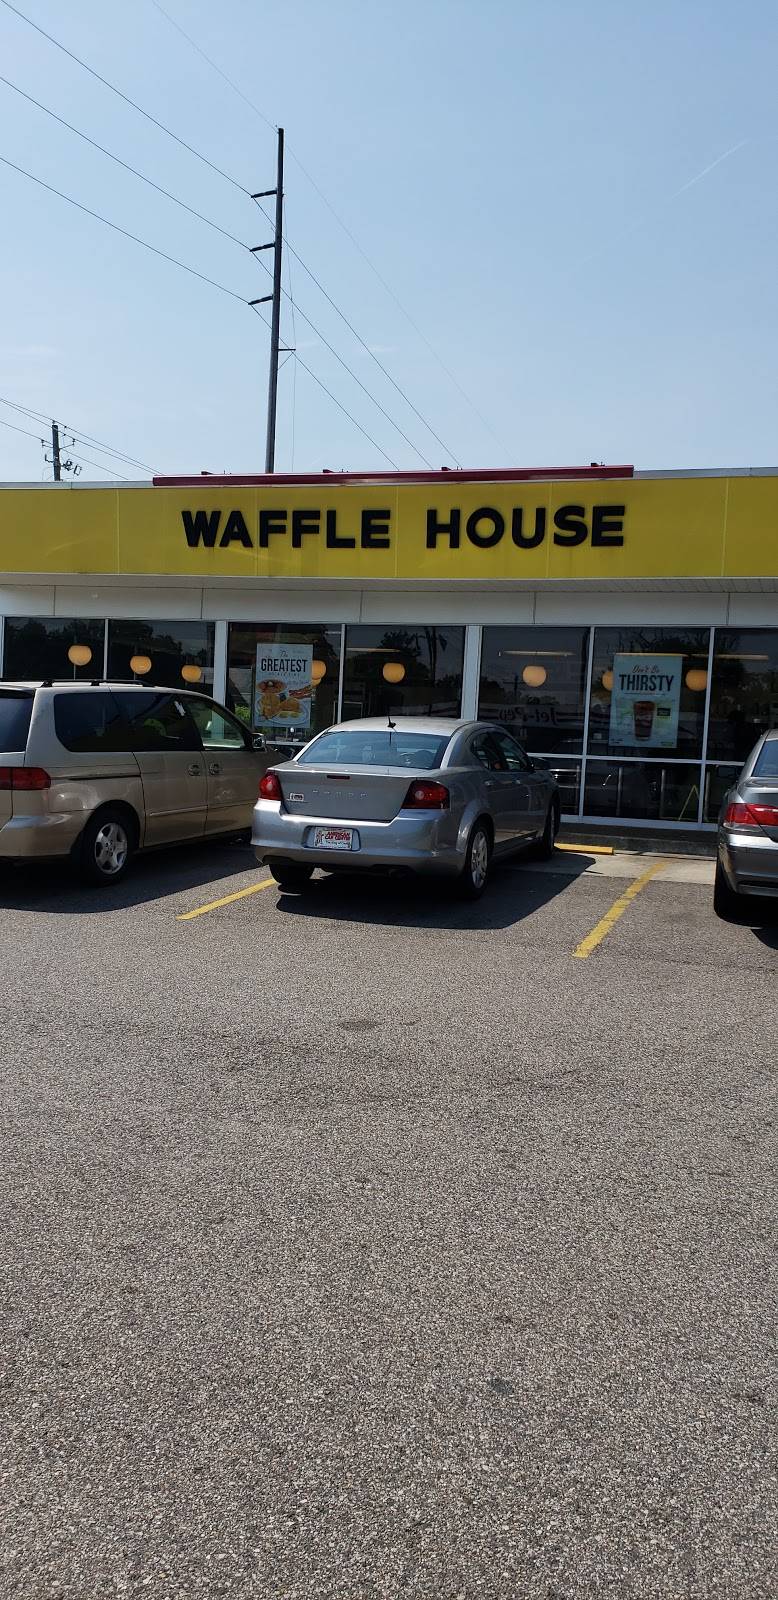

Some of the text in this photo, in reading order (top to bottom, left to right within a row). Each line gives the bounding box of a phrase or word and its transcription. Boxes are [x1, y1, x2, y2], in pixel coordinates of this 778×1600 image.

[181, 505, 626, 549] WAFFLE HOUSE
[261, 658, 308, 672] GREATEST
[618, 674, 674, 692] THIRSTY
